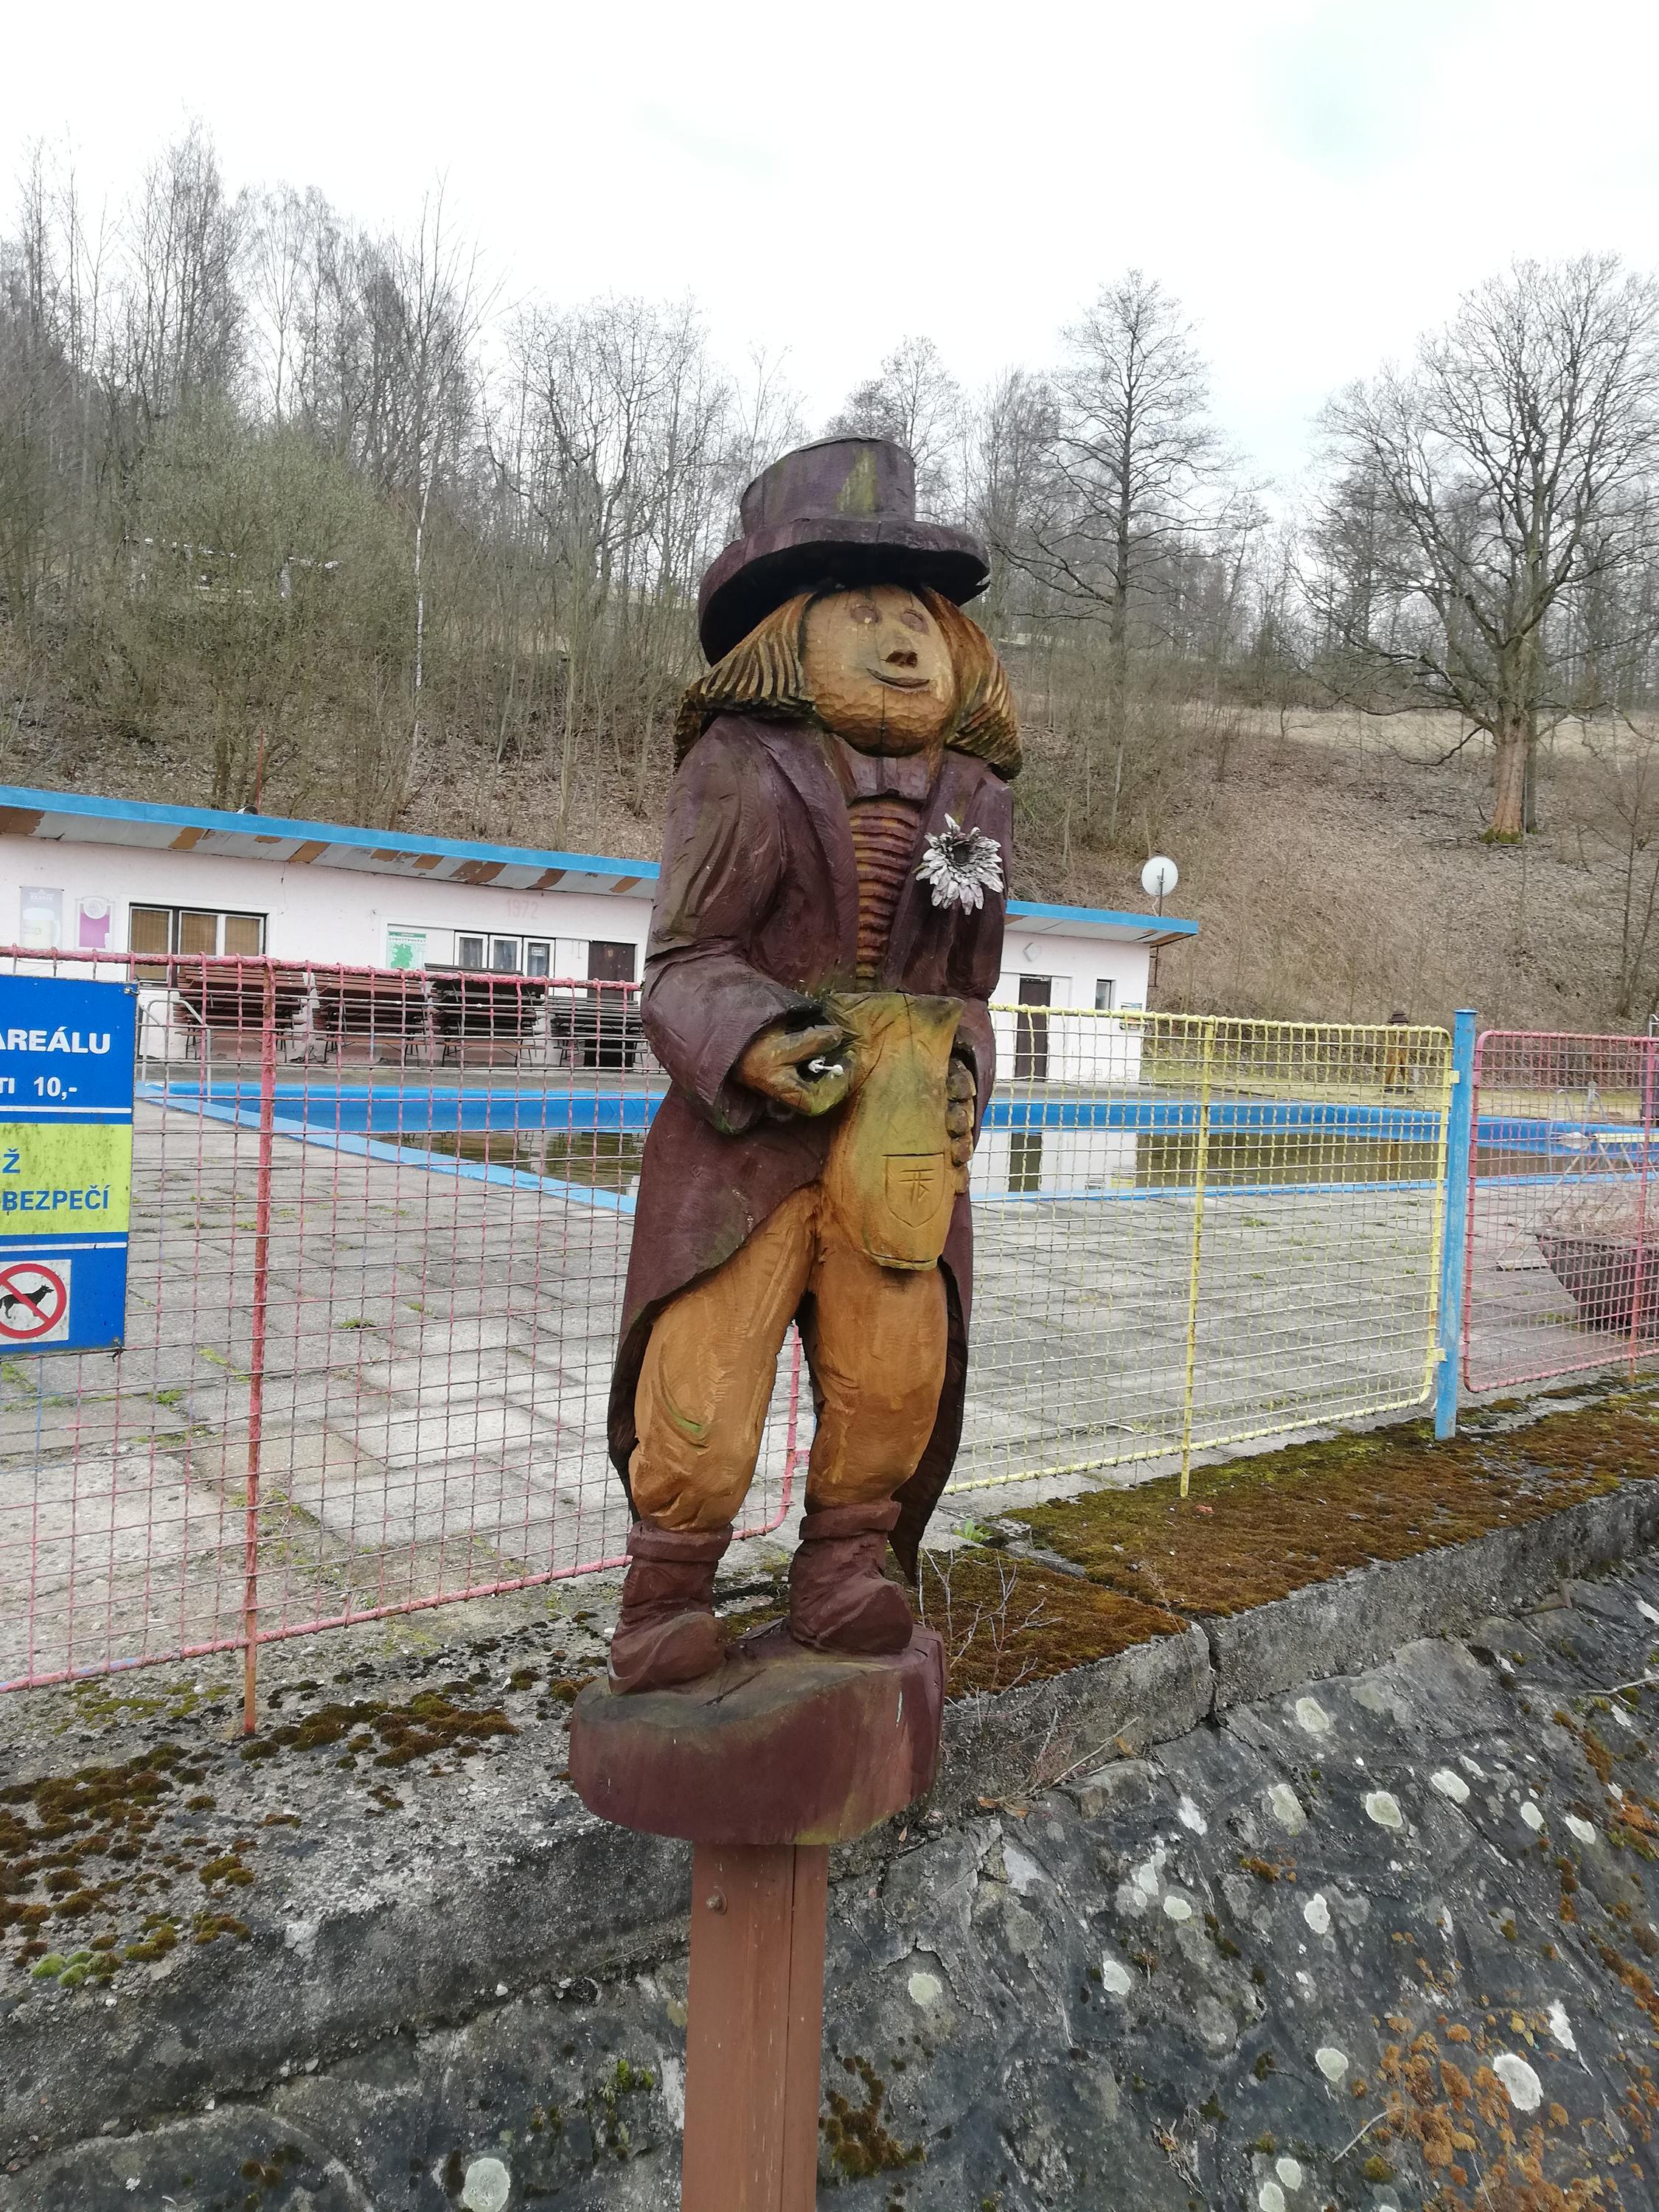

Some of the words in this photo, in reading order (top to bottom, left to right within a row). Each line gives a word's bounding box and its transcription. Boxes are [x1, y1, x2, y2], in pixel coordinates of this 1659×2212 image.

[506, 899, 538, 919] 1972
[0, 1026, 111, 1054] REÁLU
[34, 1077, 77, 1100] 10,-
[2, 1148, 21, 1173] Ž
[2, 1185, 111, 1211] BEZPEČÍ
